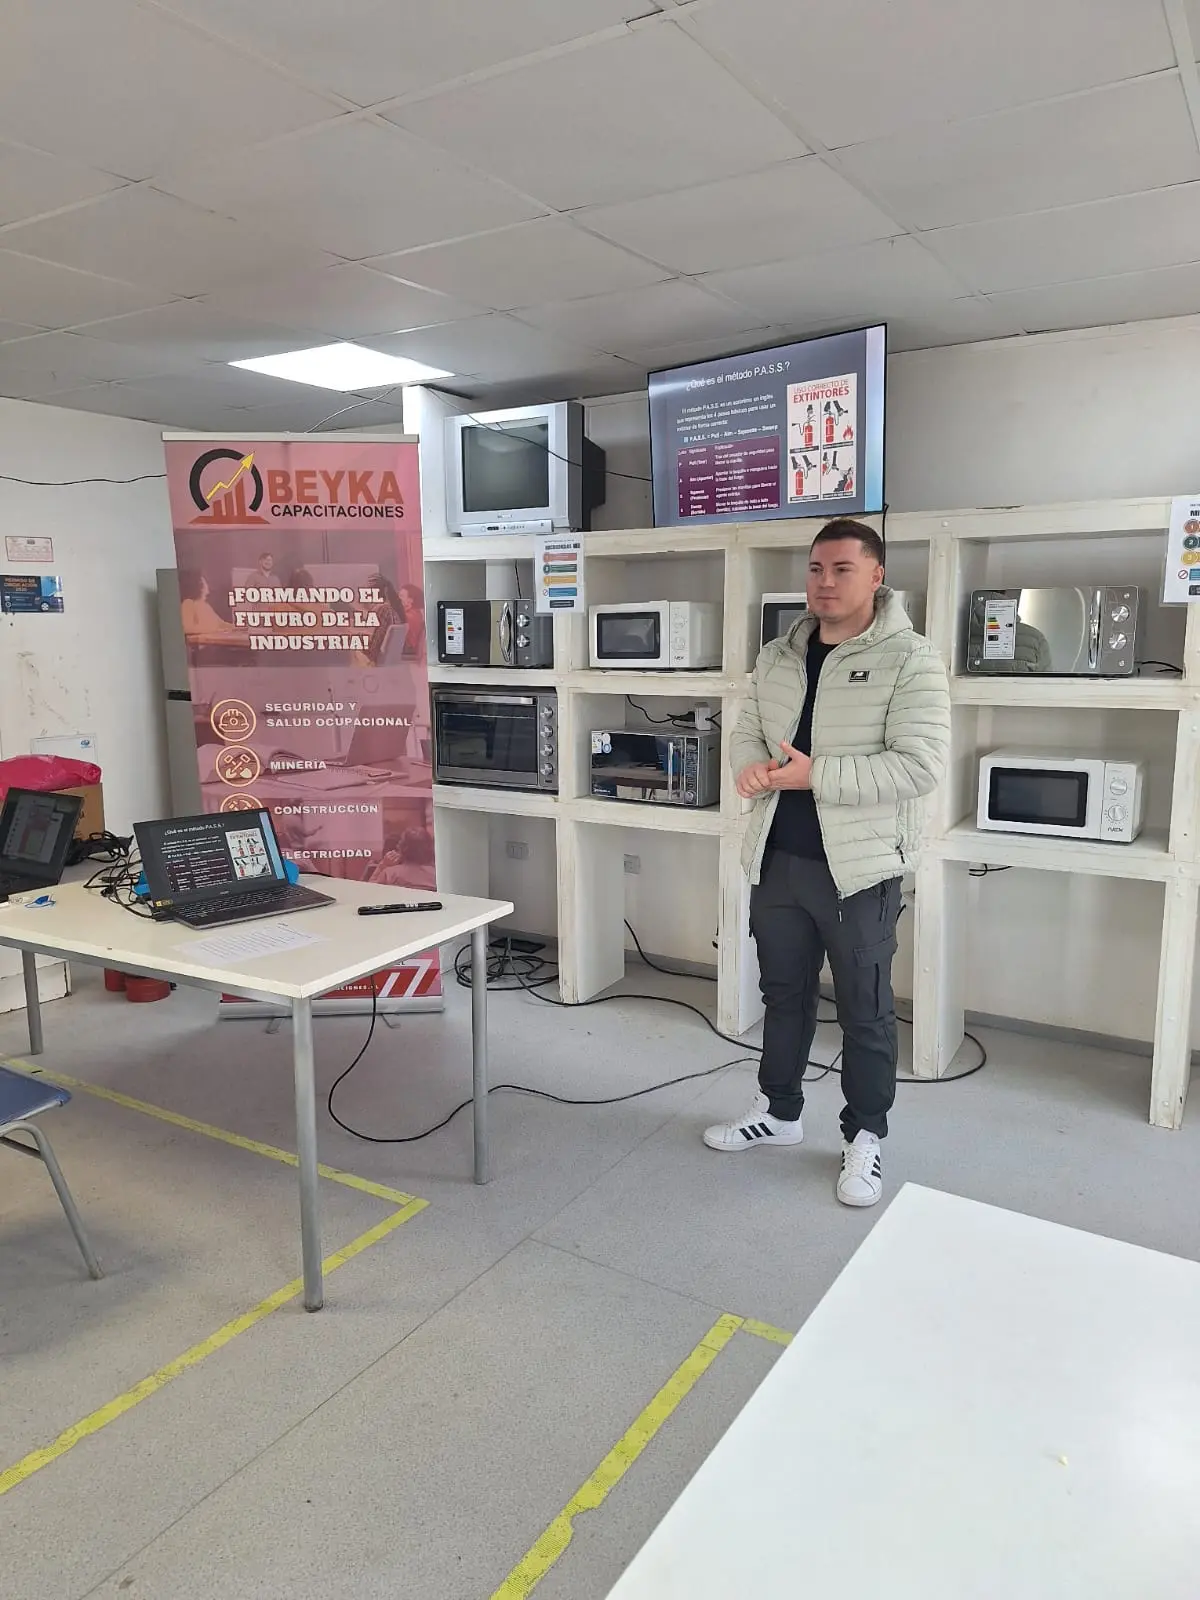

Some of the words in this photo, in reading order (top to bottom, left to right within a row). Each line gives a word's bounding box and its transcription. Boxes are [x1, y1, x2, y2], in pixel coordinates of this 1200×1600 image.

[686, 378, 706, 391] ¿Qué
[707, 378, 715, 386] es
[717, 374, 724, 384] el
[726, 370, 752, 381] método
[808, 380, 840, 392] CORRECTO
[794, 386, 850, 404] EXTINTORES
[267, 470, 404, 504] BEYKA
[271, 504, 404, 518] CAPACITACIONES
[228, 588, 354, 606] ¡FORMANDO
[359, 588, 384, 603] EL
[235, 612, 317, 627] FUTURO
[322, 612, 349, 627] DE
[354, 612, 380, 627] LA
[250, 635, 369, 650] INDUSTRIA!
[266, 703, 344, 712] SEGURIDAD
[349, 702, 357, 710] Y
[267, 718, 311, 726] SALUD
[316, 717, 412, 726] OCUPACIONAL
[270, 759, 326, 770] MINERÍA
[274, 804, 378, 814] CONSTRUCCIÓN
